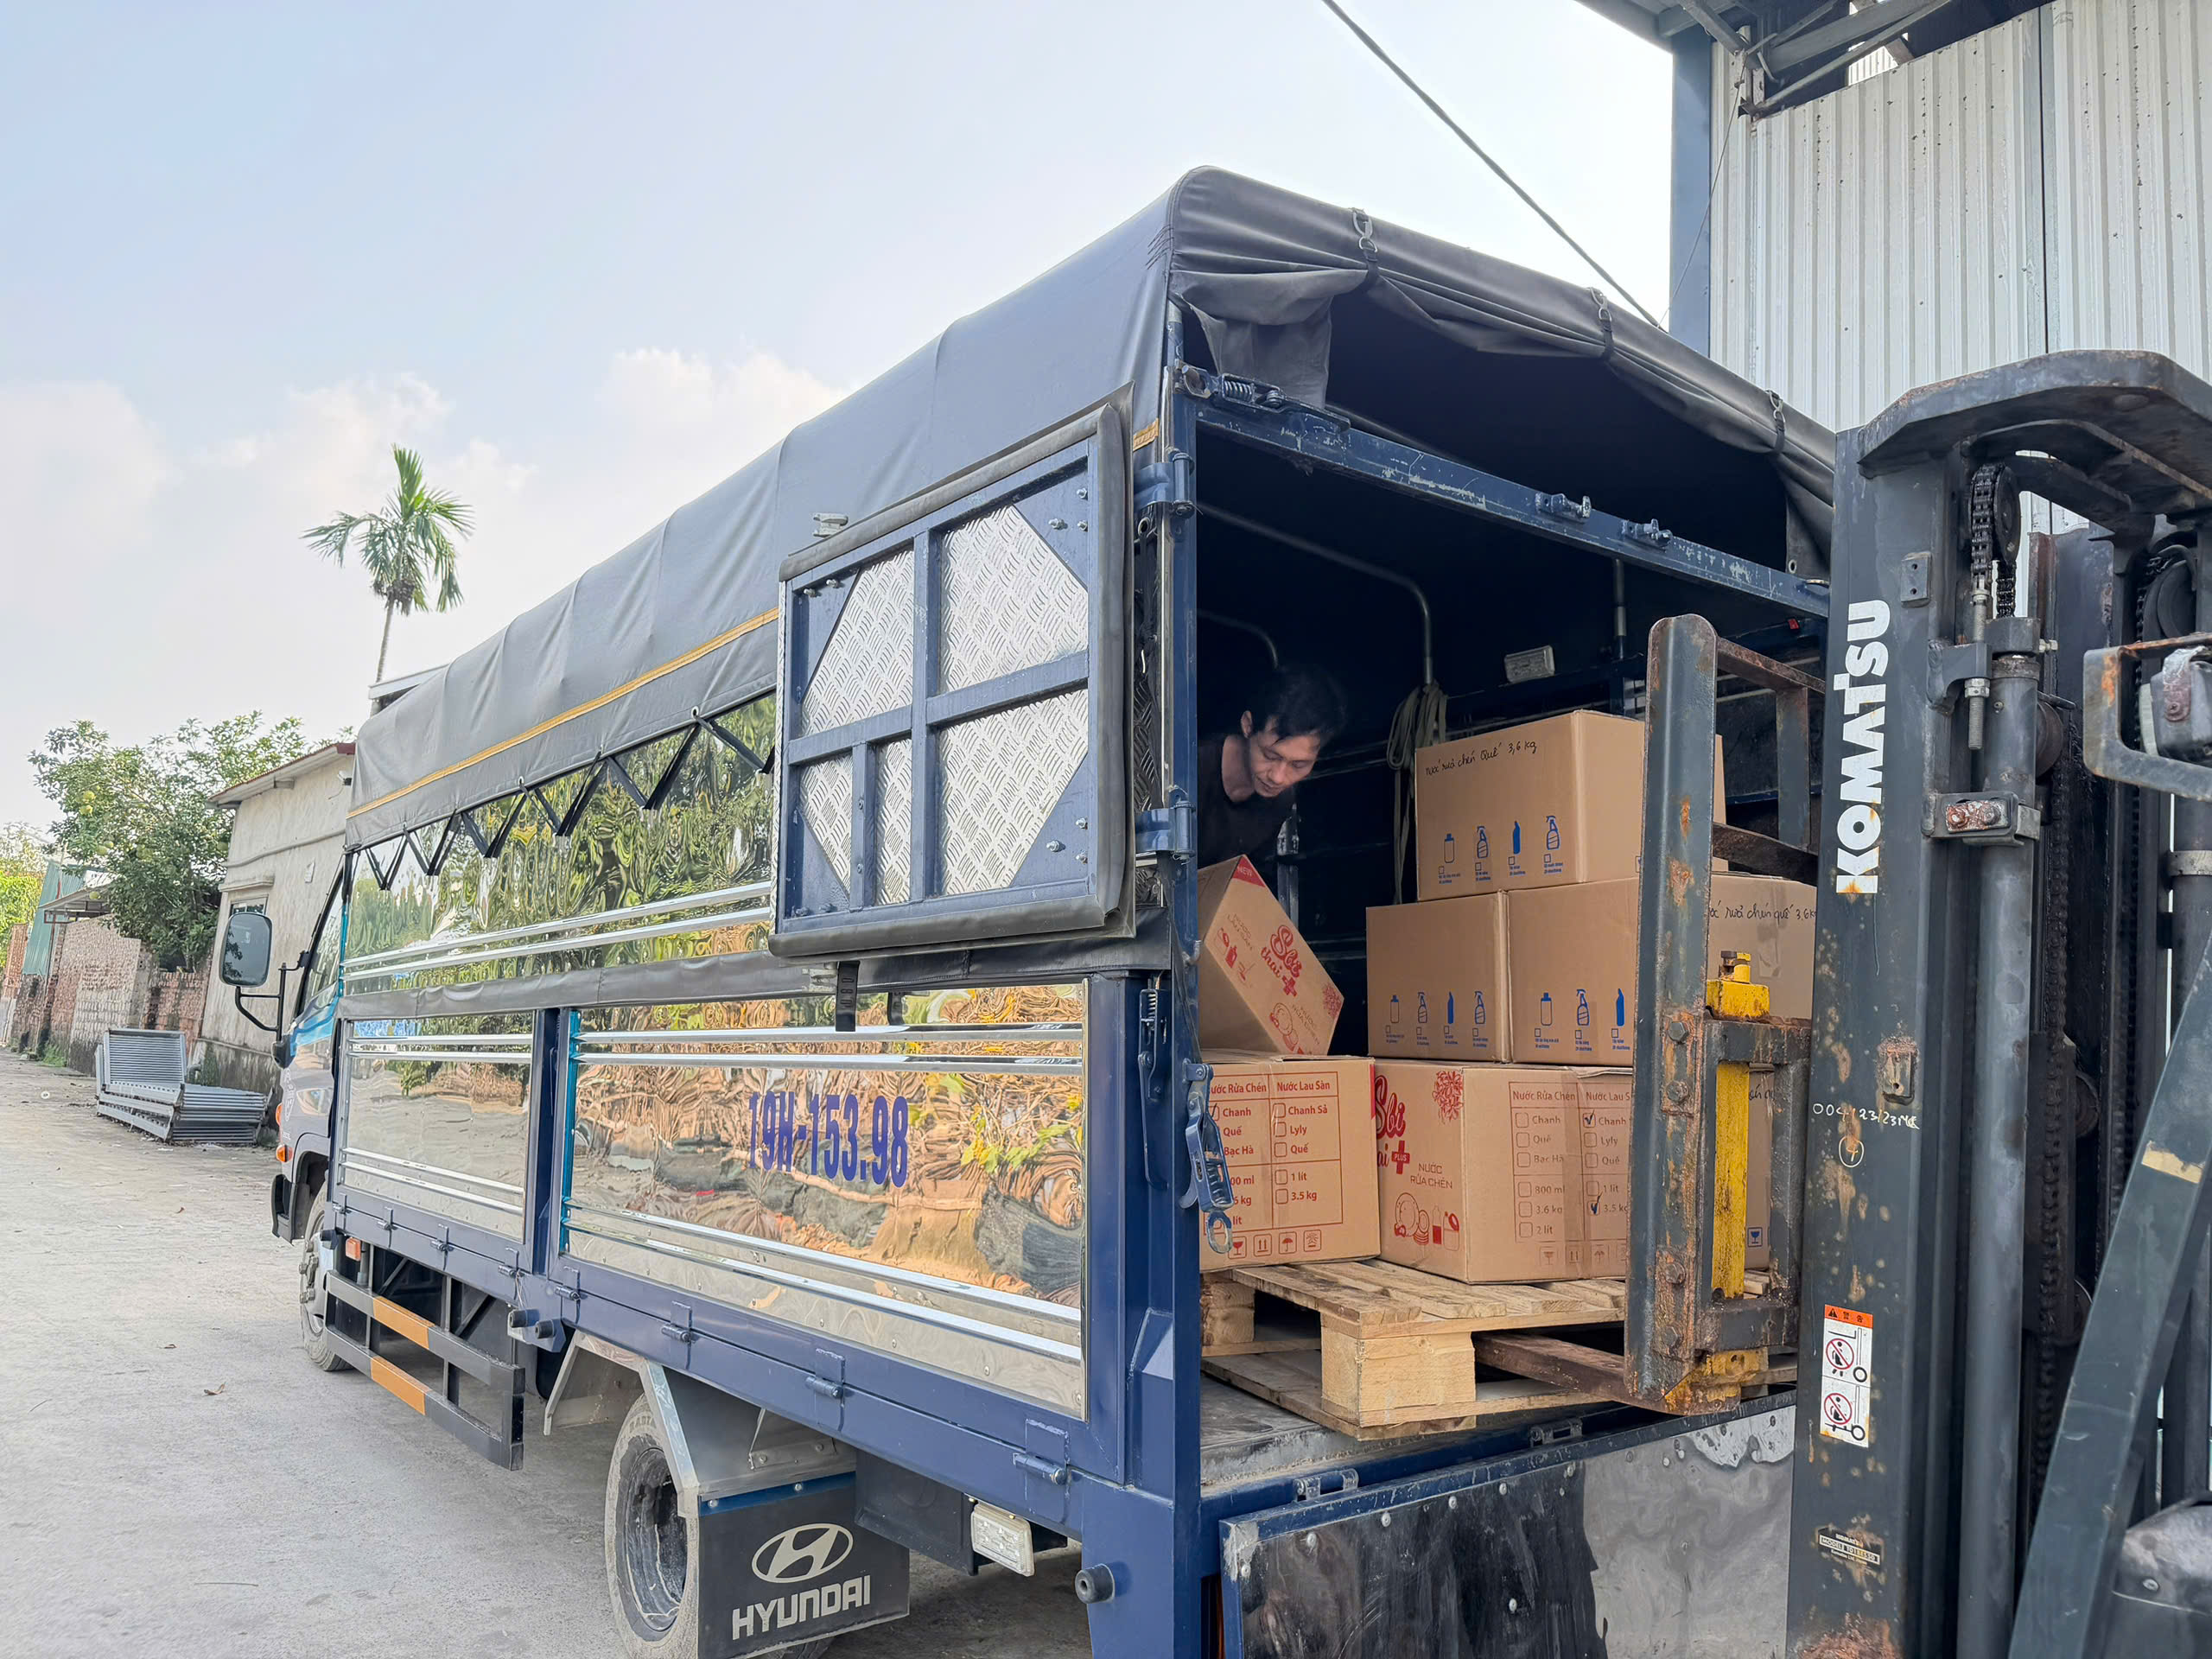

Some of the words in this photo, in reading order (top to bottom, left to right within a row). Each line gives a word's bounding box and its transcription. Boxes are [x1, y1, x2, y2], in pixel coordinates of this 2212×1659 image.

[1834, 599, 1891, 893] KOMATSU
[1237, 866, 1254, 877] NEW
[1211, 1084, 1227, 1095] ước
[1228, 1083, 1244, 1094] Rửa
[1245, 1083, 1267, 1094] Chén
[1277, 1082, 1298, 1092] Nước
[1300, 1081, 1314, 1091] Lau
[1315, 1080, 1331, 1090] Sàn
[1513, 1090, 1535, 1101] Nước
[1537, 1090, 1553, 1101] Rửa
[1554, 1091, 1576, 1101] Chén
[1586, 1090, 1607, 1102] Nước
[1609, 1091, 1624, 1102] Lau
[1223, 1107, 1251, 1118] Chanh
[1287, 1106, 1316, 1116] Chanh
[1532, 1116, 1561, 1125] Chanh
[1599, 1116, 1627, 1126] Chanh
[1223, 1125, 1243, 1137] Quế
[1290, 1125, 1307, 1136] Lyly
[748, 1090, 908, 1188] 19H-153.98
[1600, 1136, 1618, 1147] Lyly
[1224, 1147, 1240, 1159] Bạc
[1242, 1145, 1255, 1154] Hà
[1290, 1142, 1309, 1154] Quế
[1394, 1153, 1408, 1162] PLUS
[1418, 1160, 1443, 1174] NƯỚC
[1230, 1176, 1242, 1186] 00
[1243, 1174, 1255, 1185] ml
[1427, 1176, 1452, 1190] CHÉN
[1535, 1185, 1552, 1194] 800
[1554, 1184, 1566, 1194] ml
[1240, 1195, 1252, 1206] kg
[1291, 1192, 1305, 1201] 3.5
[1306, 1191, 1318, 1201] kg
[1535, 1205, 1550, 1215] 3.6
[1604, 1204, 1617, 1213] 3.5
[1537, 1225, 1541, 1235] 2
[732, 1574, 871, 1641] HYUNDAI
